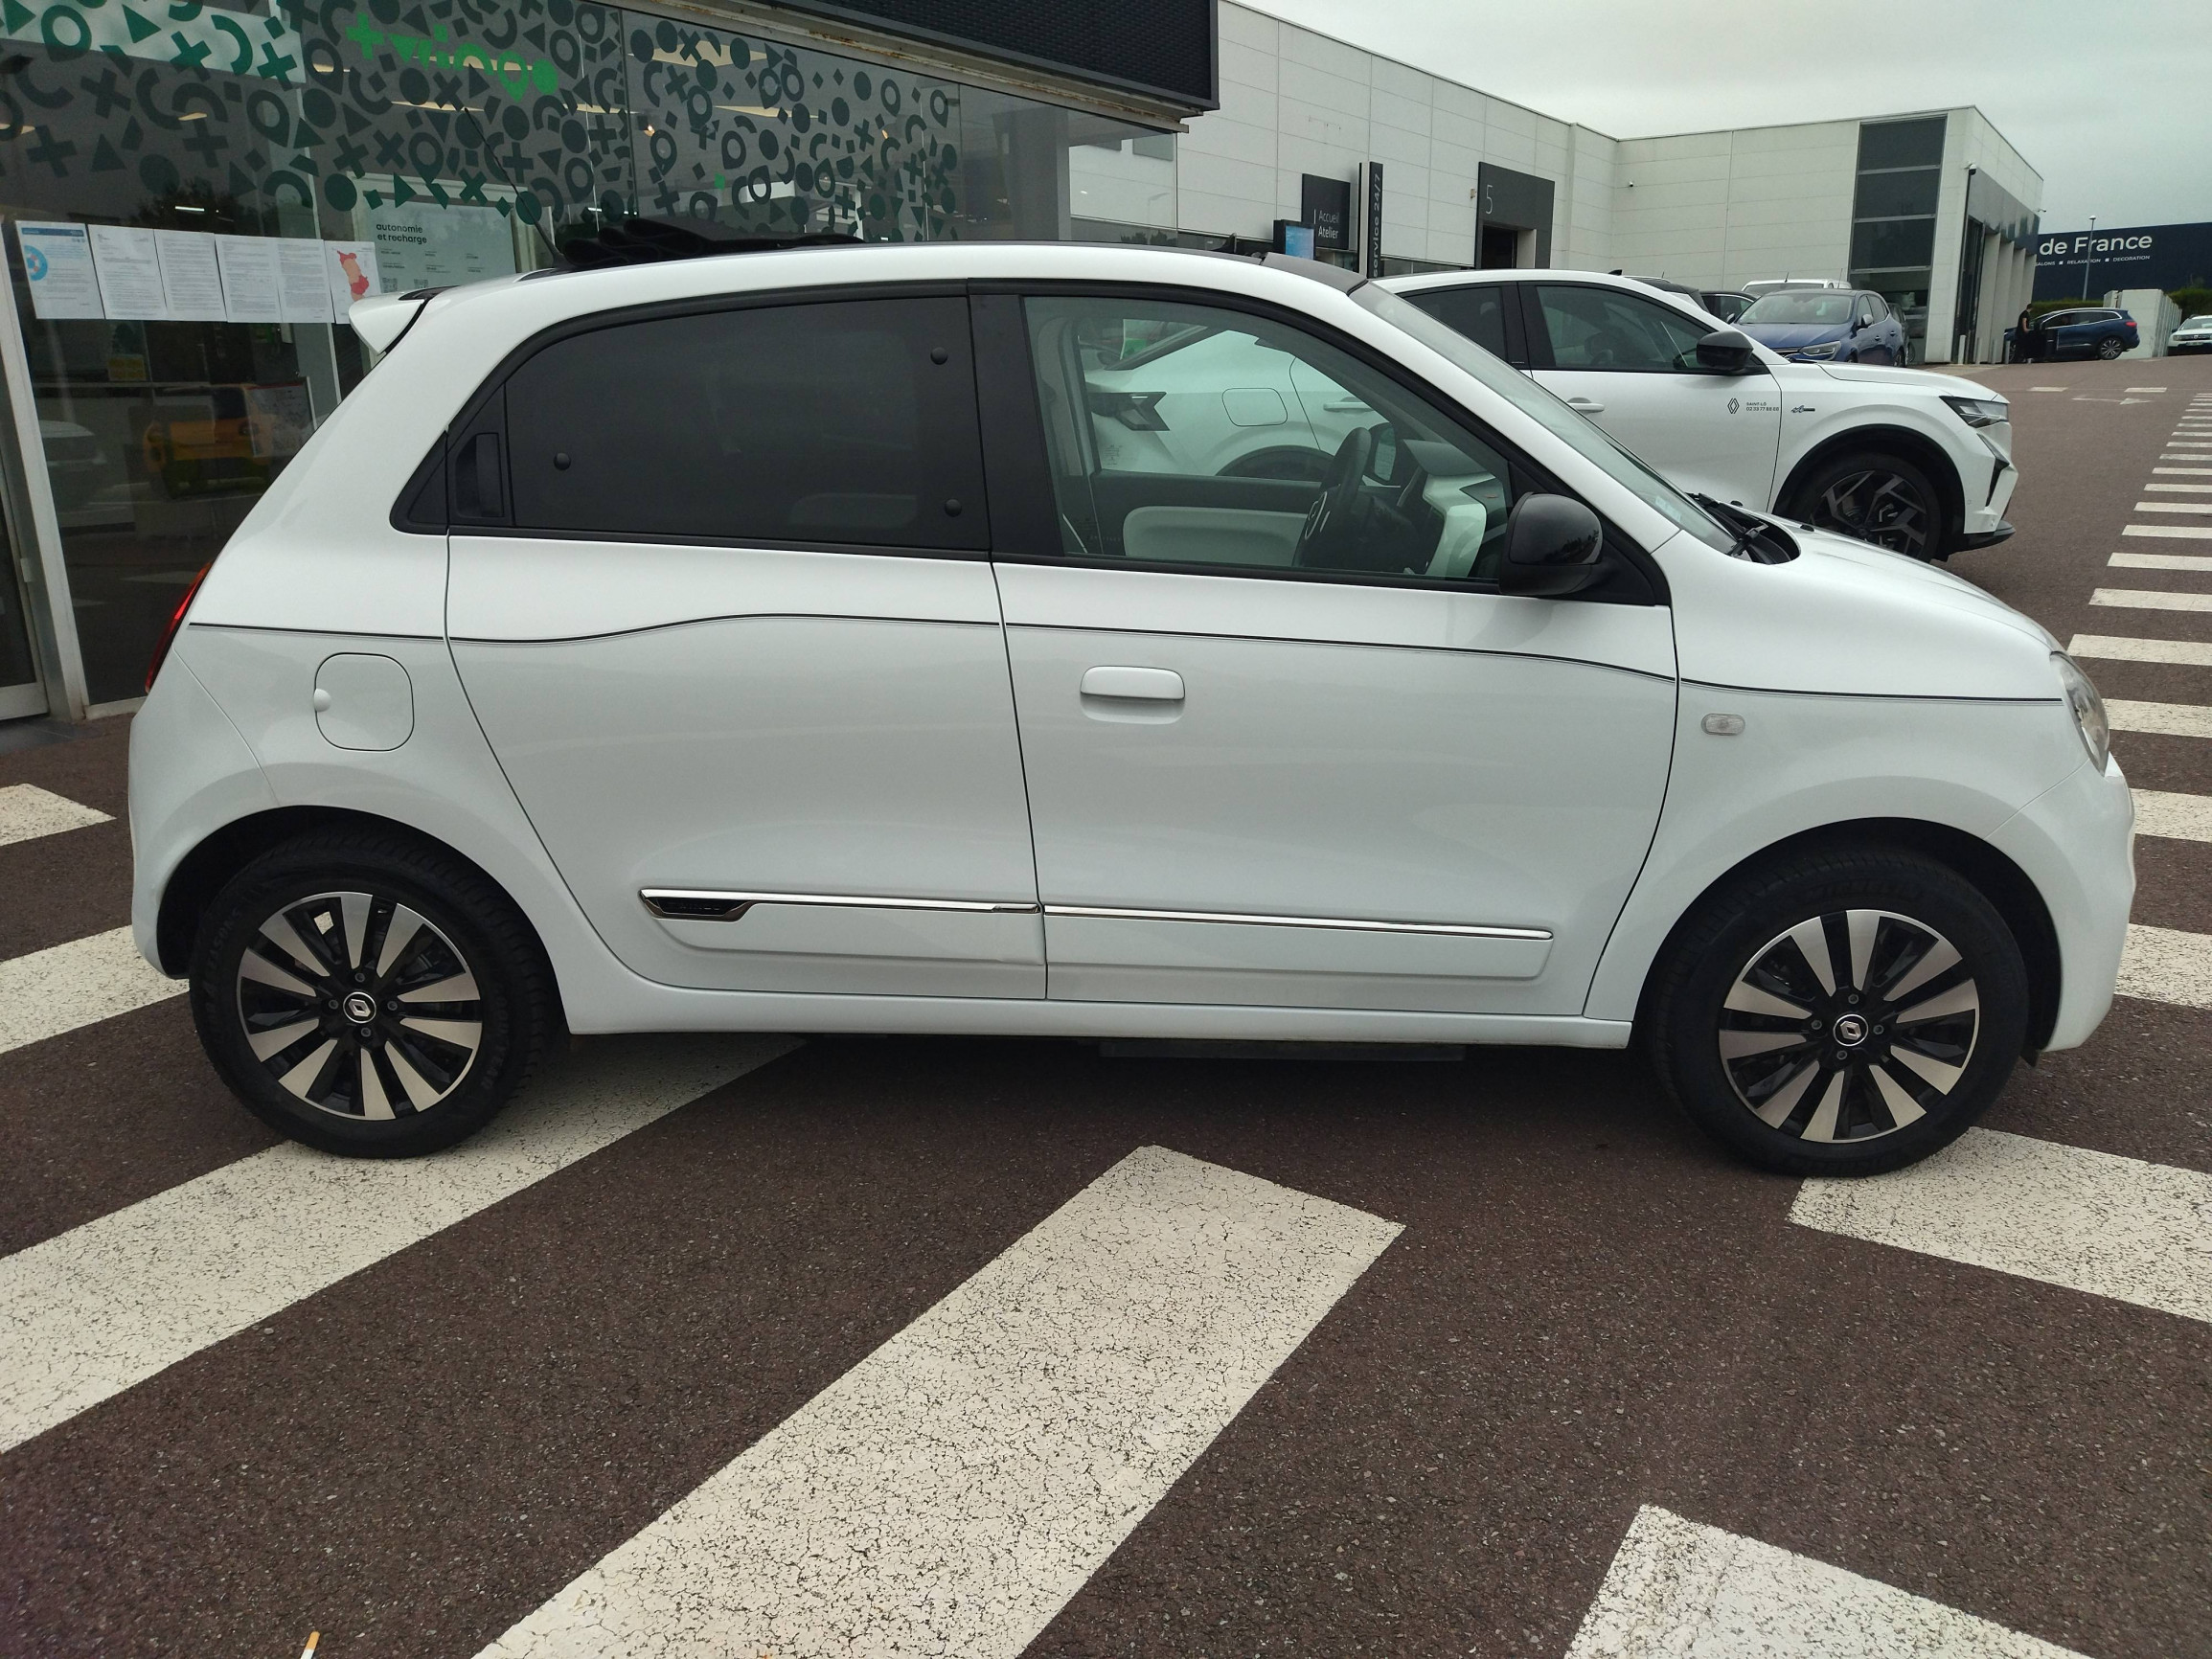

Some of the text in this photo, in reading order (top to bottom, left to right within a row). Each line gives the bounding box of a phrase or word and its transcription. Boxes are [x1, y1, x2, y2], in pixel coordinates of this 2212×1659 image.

[1485, 184, 1494, 215] 5
[1318, 210, 1340, 224] Accueil
[376, 222, 423, 234] autonomie
[1318, 226, 1339, 239] Atelier
[377, 233, 427, 245] et recharge
[2039, 235, 2153, 256] de France
